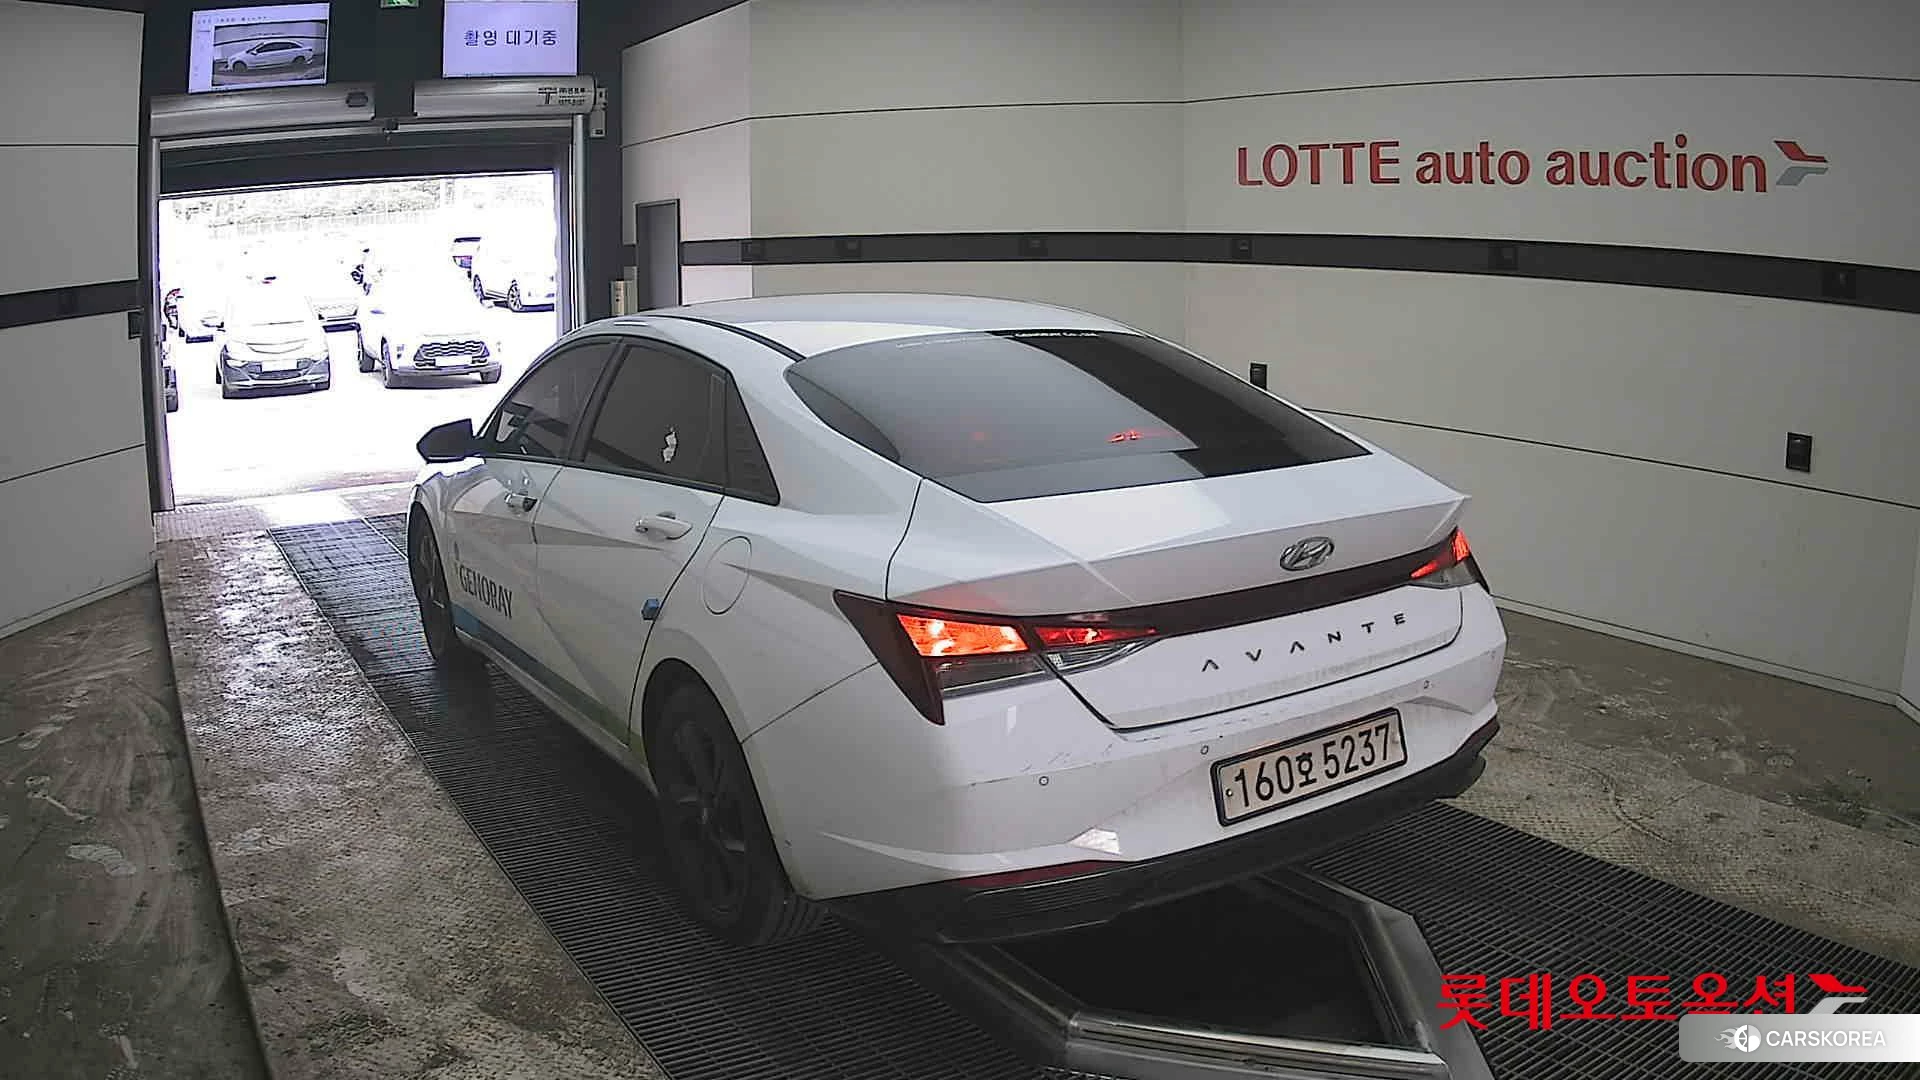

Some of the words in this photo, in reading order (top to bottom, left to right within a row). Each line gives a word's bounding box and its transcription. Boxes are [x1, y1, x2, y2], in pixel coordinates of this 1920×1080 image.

[506, 30, 557, 46] 대기중
[1238, 141, 1400, 187] LOTTE
[1415, 141, 1530, 186] auto
[1546, 134, 1767, 192] auction
[1201, 613, 1406, 672] AVANTE
[1234, 752, 1317, 807] 160호
[1323, 723, 1390, 779] 5237
